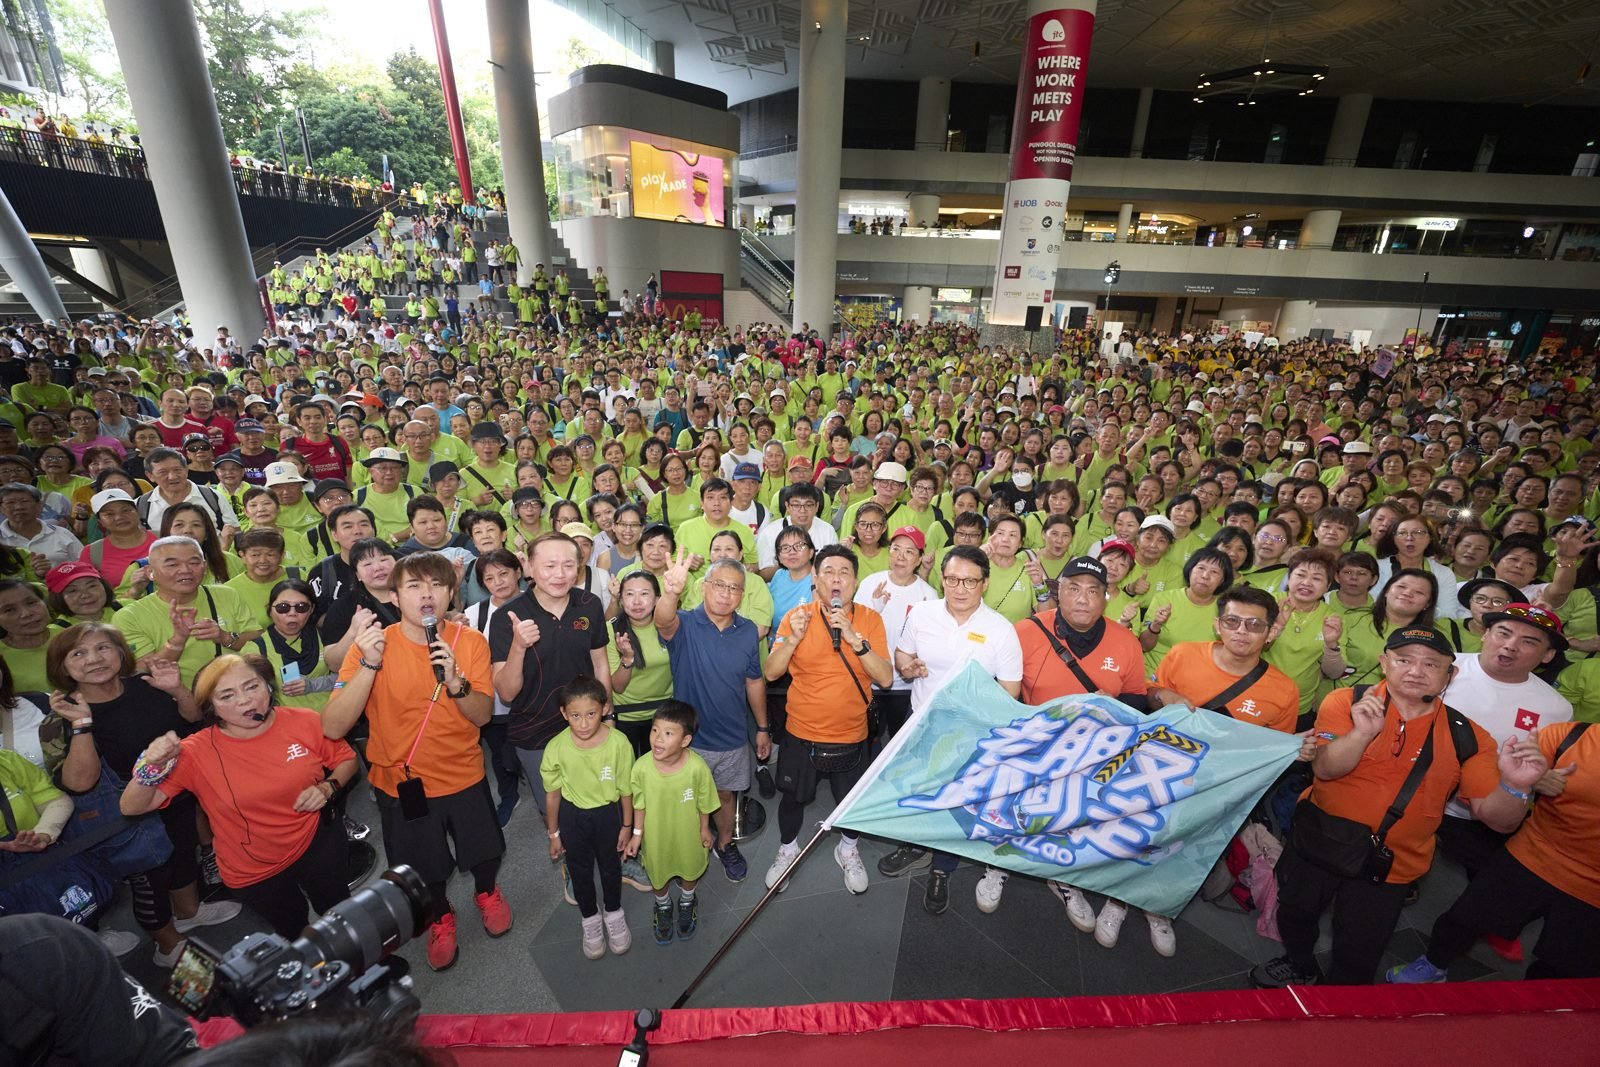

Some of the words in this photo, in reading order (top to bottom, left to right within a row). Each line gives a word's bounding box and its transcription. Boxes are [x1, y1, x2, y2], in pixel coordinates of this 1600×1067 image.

[1052, 31, 1063, 39] jtc
[1038, 55, 1082, 70] WHERE
[1035, 74, 1077, 88] WORK
[1032, 92, 1072, 105] MEETS
[1030, 109, 1064, 123] PLAY
[1061, 157, 1074, 165] MARC
[640, 172, 666, 190] play
[661, 178, 687, 193] MADE
[1100, 657, 1120, 672] 走
[1236, 699, 1262, 717] 走
[286, 743, 309, 762] 走
[600, 765, 615, 782] 走
[680, 788, 695, 804] 走
